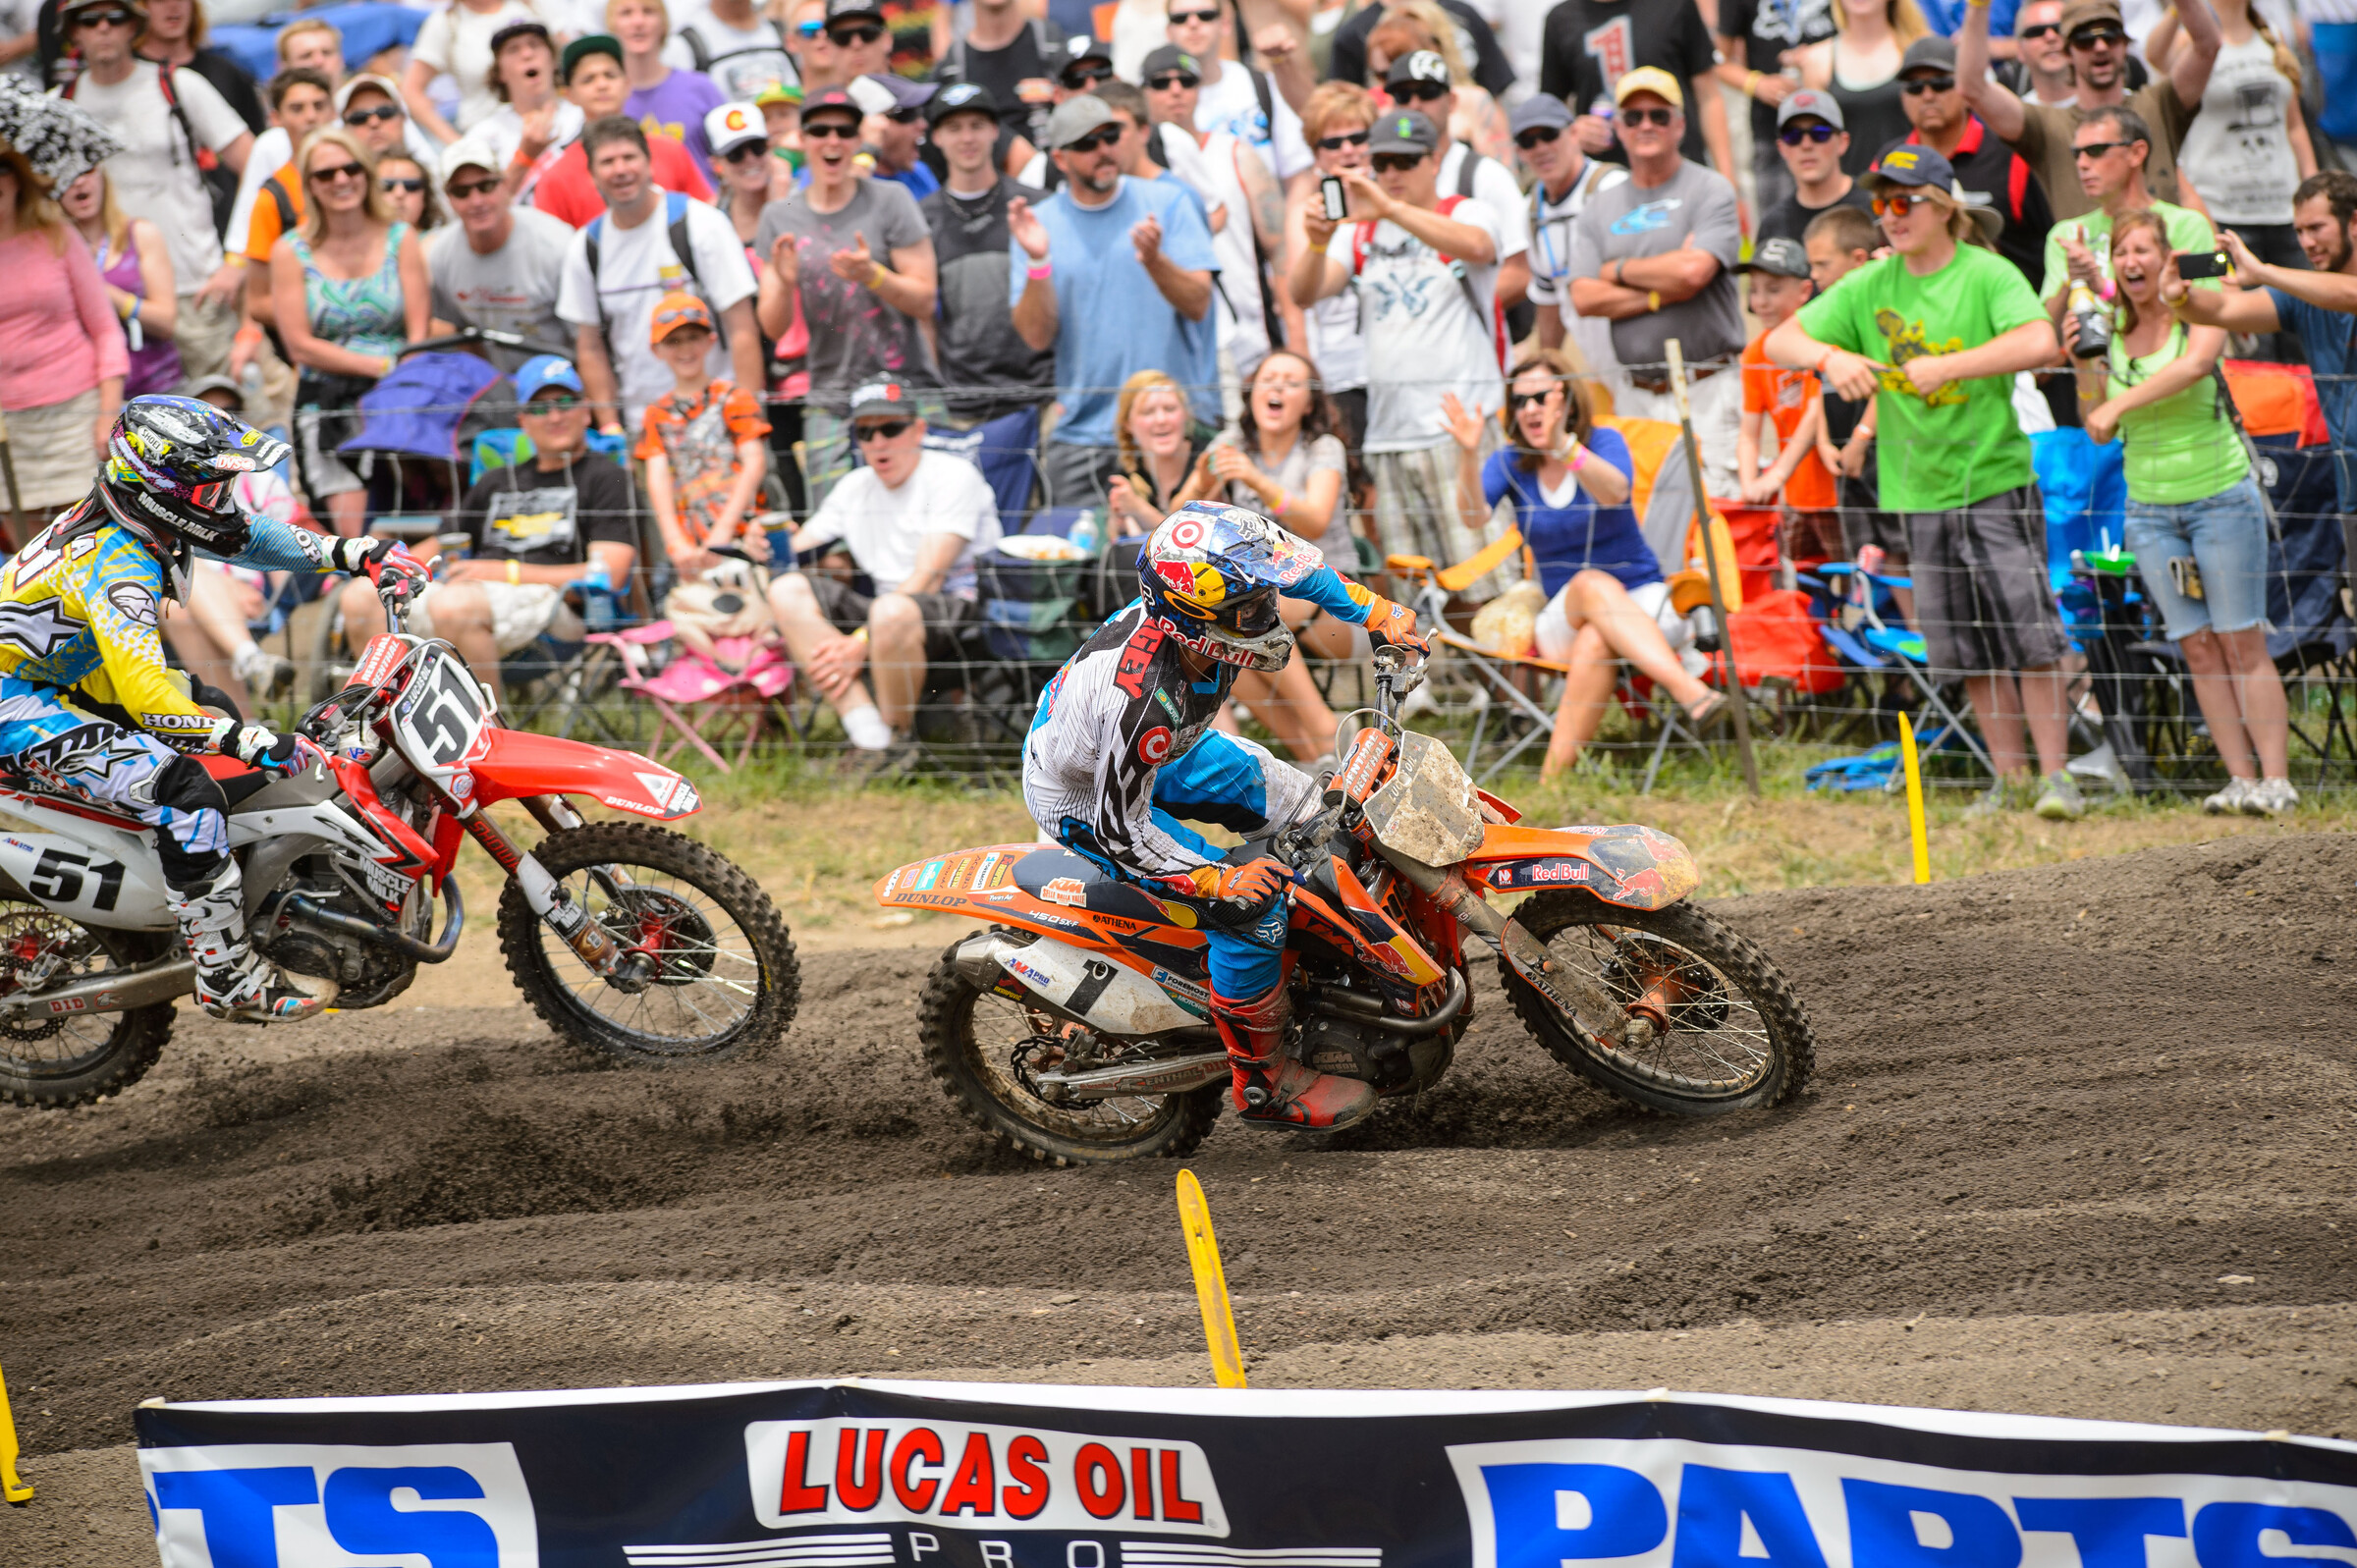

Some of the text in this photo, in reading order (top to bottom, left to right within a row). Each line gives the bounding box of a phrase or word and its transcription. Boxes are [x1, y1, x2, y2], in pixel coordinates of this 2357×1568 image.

[140, 428, 163, 451] SHOEI
[138, 491, 220, 542] MUSCLE MILK
[1280, 555, 1306, 584] Red
[1158, 615, 1256, 668] Red Bull
[360, 635, 392, 682] RENTHAL
[1113, 619, 1167, 699] GEY
[408, 665, 432, 705] LUCAS OIL
[141, 713, 218, 730] HOND
[411, 659, 483, 766] 51
[1352, 740, 1388, 797] RENTHAL
[604, 795, 665, 815] DUNLOP
[28, 847, 127, 912] 51
[359, 855, 411, 894] MUSCLE
[1049, 880, 1083, 893] KTM
[1532, 863, 1590, 882] Red Bull
[366, 875, 401, 905] MILK
[894, 892, 967, 907] DUNLOP
[1028, 910, 1060, 923] 450
[1101, 917, 1136, 931] ATHENA
[1006, 957, 1051, 985] AMA PRO
[1063, 958, 1120, 1017] 1
[1168, 975, 1210, 999] FOREMOST
[50, 997, 85, 1012] DID
[1533, 980, 1578, 1017] ATHENA
[779, 1427, 1203, 1526] LUCAS OIL
[145, 1466, 500, 1568] TS
